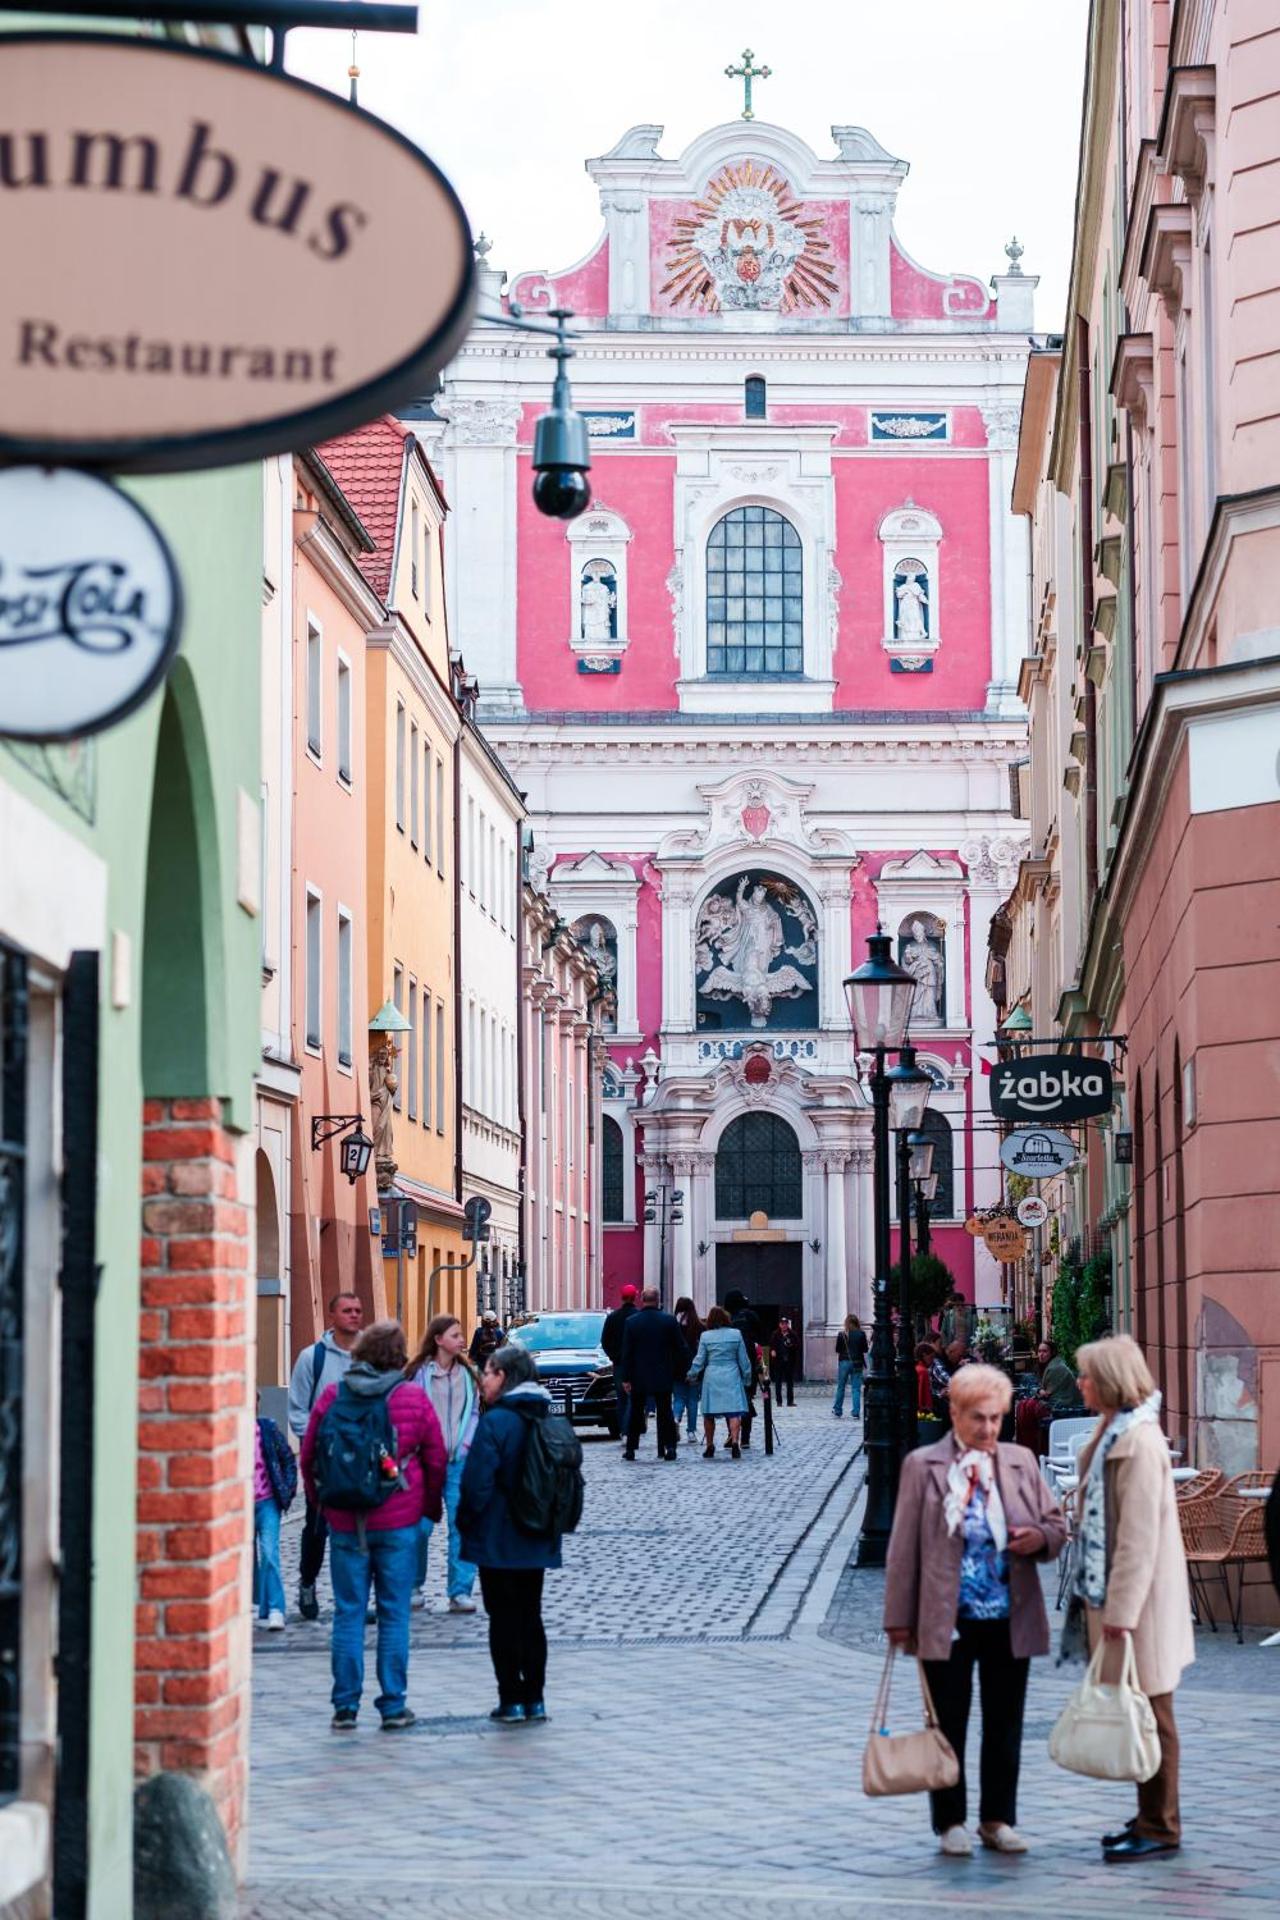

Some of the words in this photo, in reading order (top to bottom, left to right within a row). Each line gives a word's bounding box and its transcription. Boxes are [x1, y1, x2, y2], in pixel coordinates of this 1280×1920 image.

[15, 318, 341, 382] Restaurant
[999, 1070, 1103, 1099] żabka
[350, 1149, 357, 1161] 2
